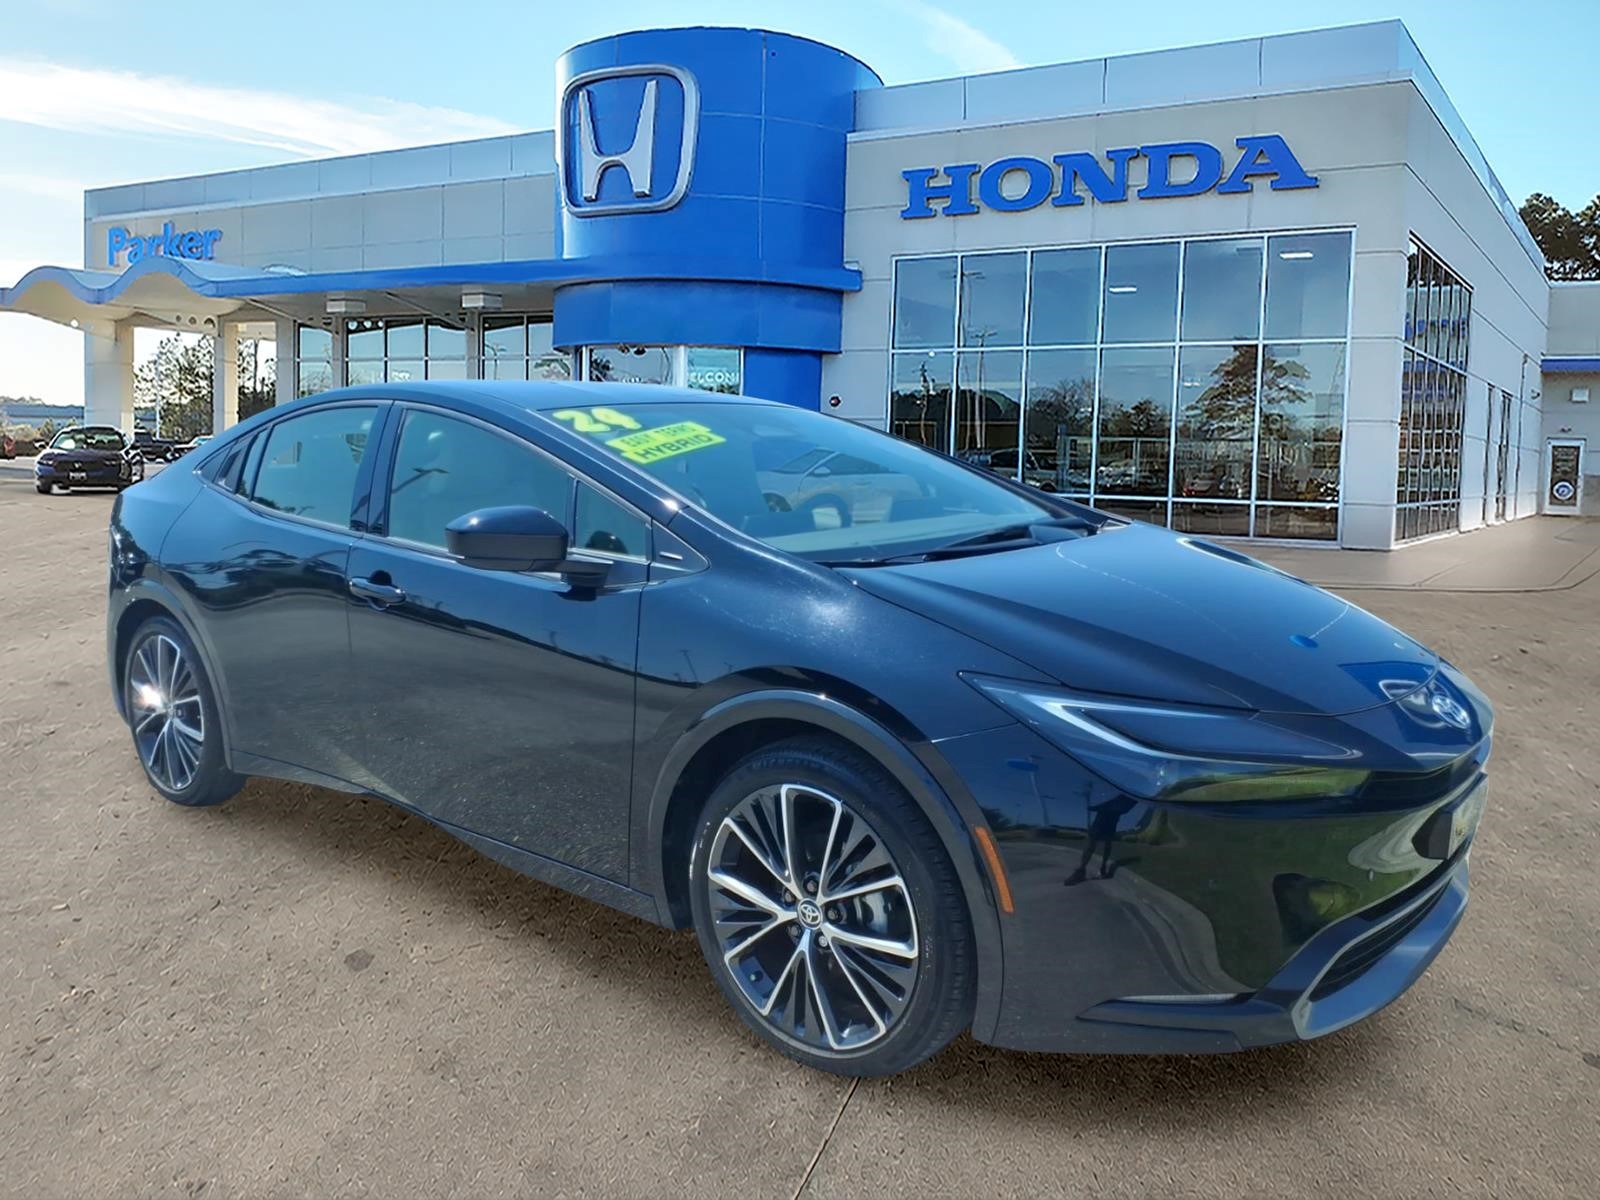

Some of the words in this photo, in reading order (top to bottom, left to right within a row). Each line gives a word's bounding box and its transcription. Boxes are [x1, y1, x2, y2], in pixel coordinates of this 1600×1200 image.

[901, 134, 1320, 219] HONDA
[107, 220, 223, 267] Parker
[633, 433, 714, 459] HYBRID
